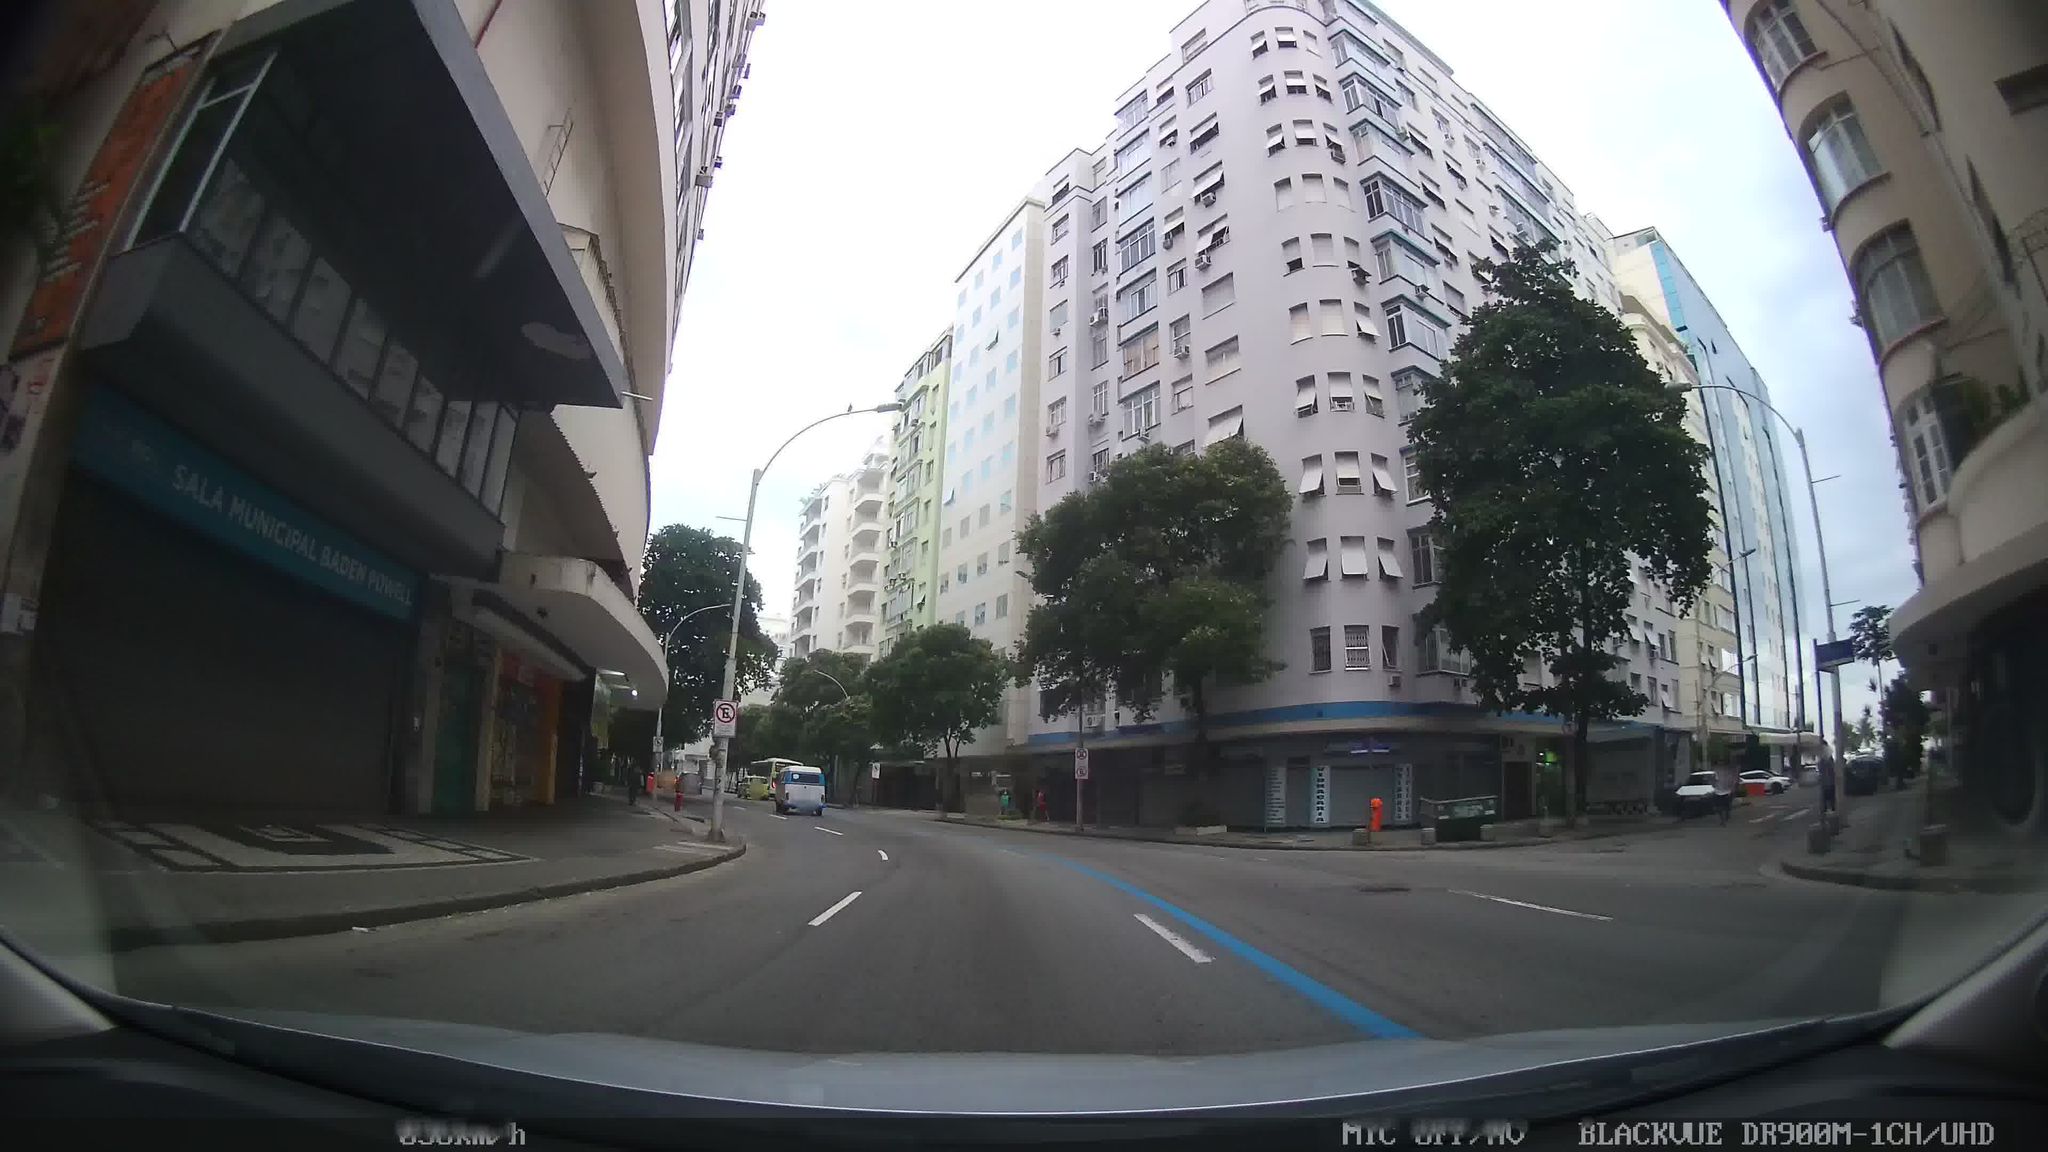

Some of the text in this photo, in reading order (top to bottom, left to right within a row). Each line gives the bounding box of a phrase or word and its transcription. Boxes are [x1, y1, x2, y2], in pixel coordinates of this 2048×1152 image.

[172, 464, 414, 607] SALA MUNICIPAL BADEN POWELL
